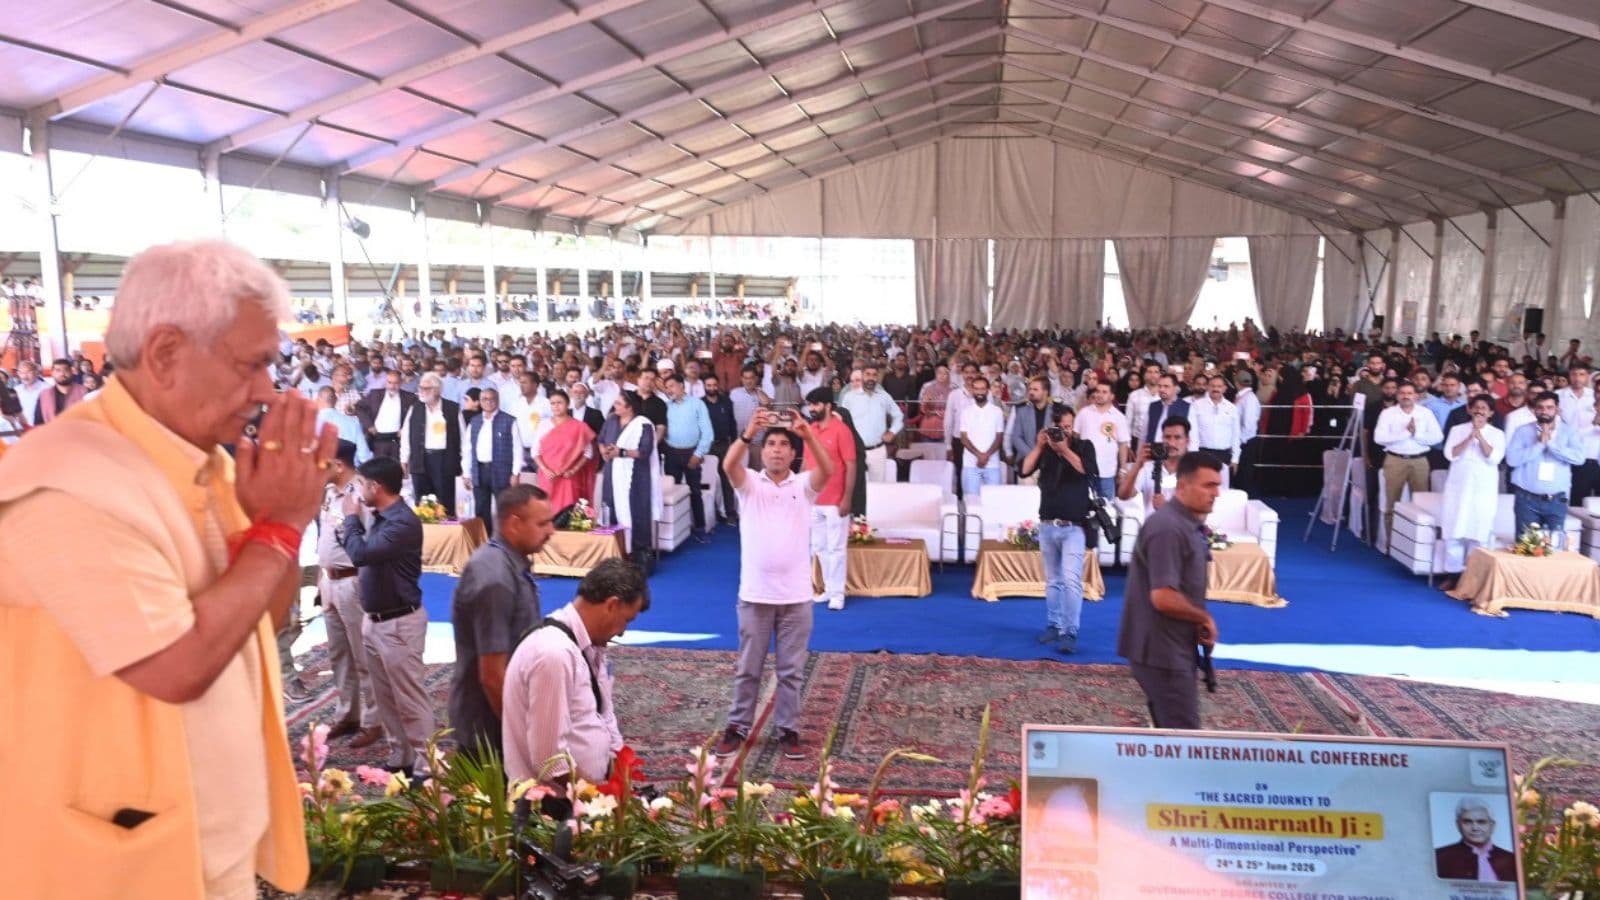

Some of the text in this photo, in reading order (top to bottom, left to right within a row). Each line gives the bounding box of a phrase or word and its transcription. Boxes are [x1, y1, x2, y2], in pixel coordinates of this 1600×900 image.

[1116, 742, 1409, 768] TWO-DAY INTERNATIONAL CONFERENCE
[1255, 783, 1268, 791] ON
[1222, 793, 1264, 805] SACRED
[1267, 795, 1314, 807] JOURNEY
[1317, 797, 1331, 807] TO
[1158, 808, 1208, 828] Shri
[1213, 812, 1334, 835] Amarnath
[1340, 817, 1358, 839] Ji
[1169, 837, 1177, 847] A
[1181, 838, 1285, 853] Multi-Dimensional
[1266, 860, 1288, 871] June
[1268, 891, 1318, 900] COLLEGE
